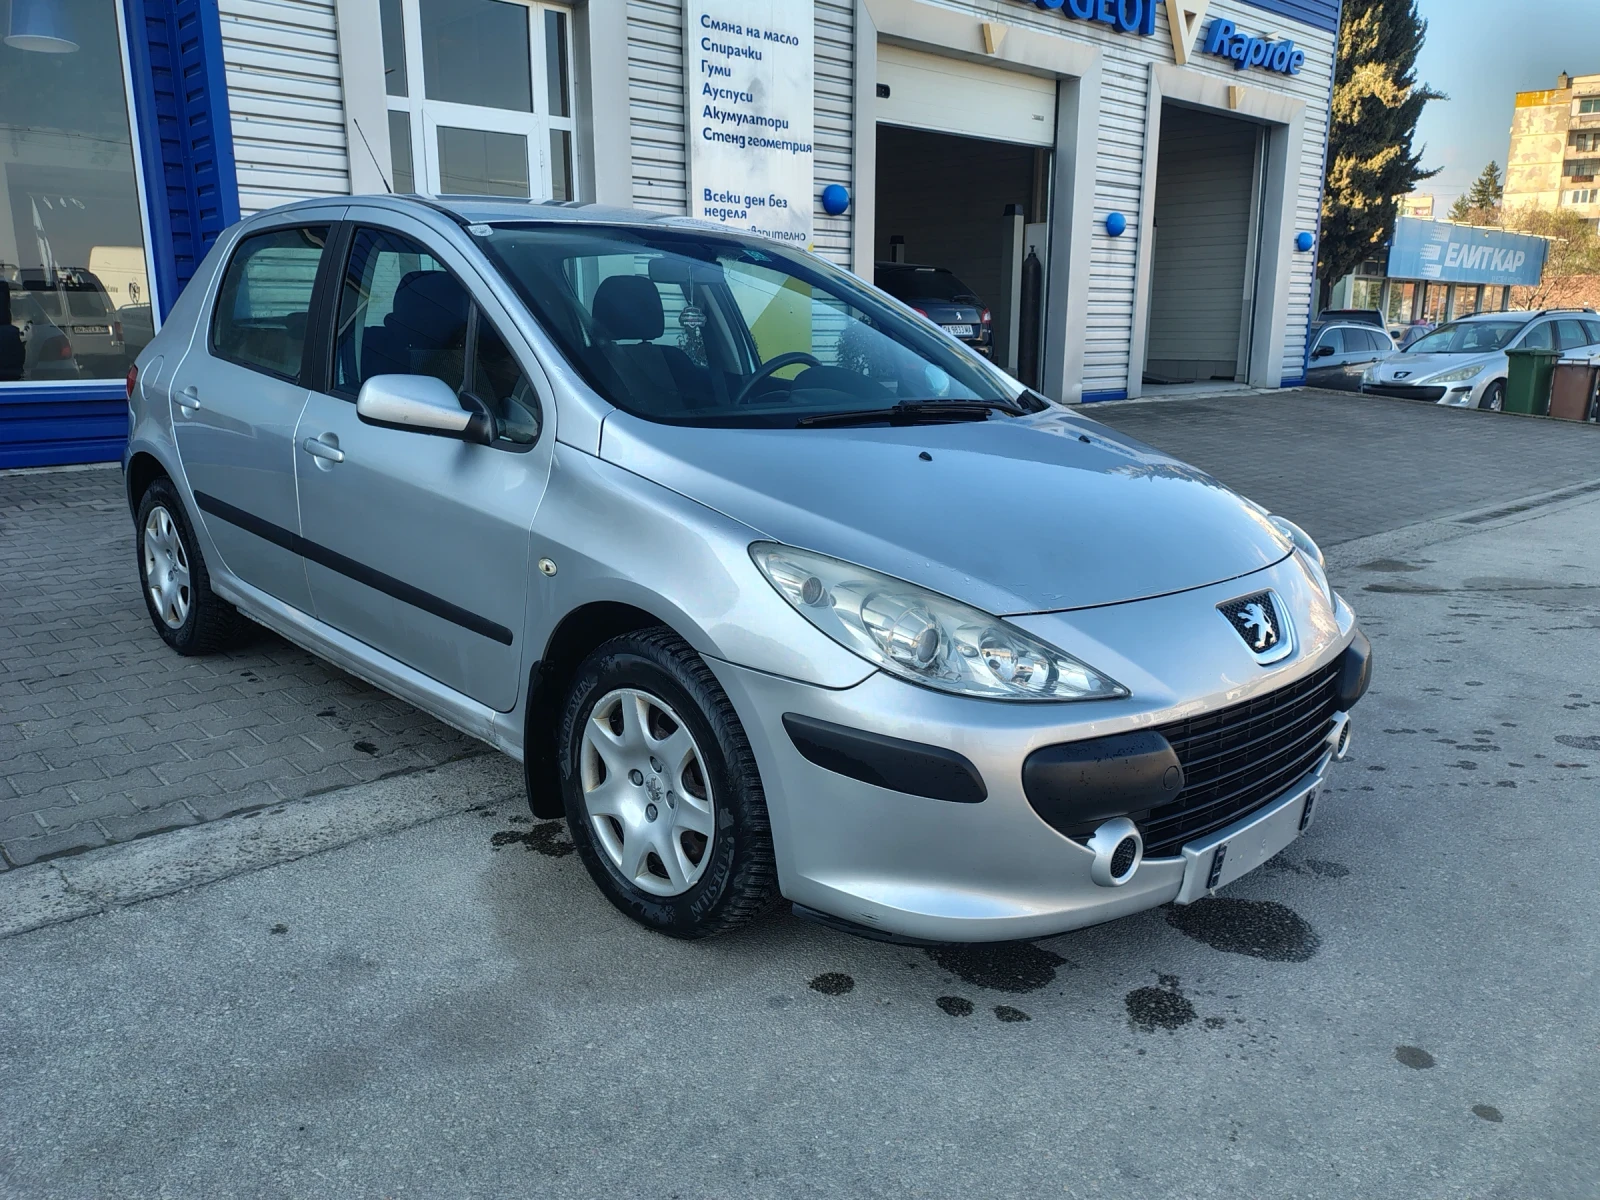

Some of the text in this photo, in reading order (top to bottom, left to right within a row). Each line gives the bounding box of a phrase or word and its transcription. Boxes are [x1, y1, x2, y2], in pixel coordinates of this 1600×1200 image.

[701, 14, 799, 46] Смяна на масло
[701, 37, 762, 61] Спирачки
[1206, 18, 1305, 76] Rapide
[701, 59, 732, 78] Гуми
[702, 82, 753, 104] Ауспуси
[702, 105, 789, 132] Акумулатори
[703, 127, 812, 155] Стенд геометрия
[704, 188, 788, 209] Всеки ден без
[704, 207, 747, 221] неделя
[1444, 242, 1526, 273] ЕЛИТКАР
